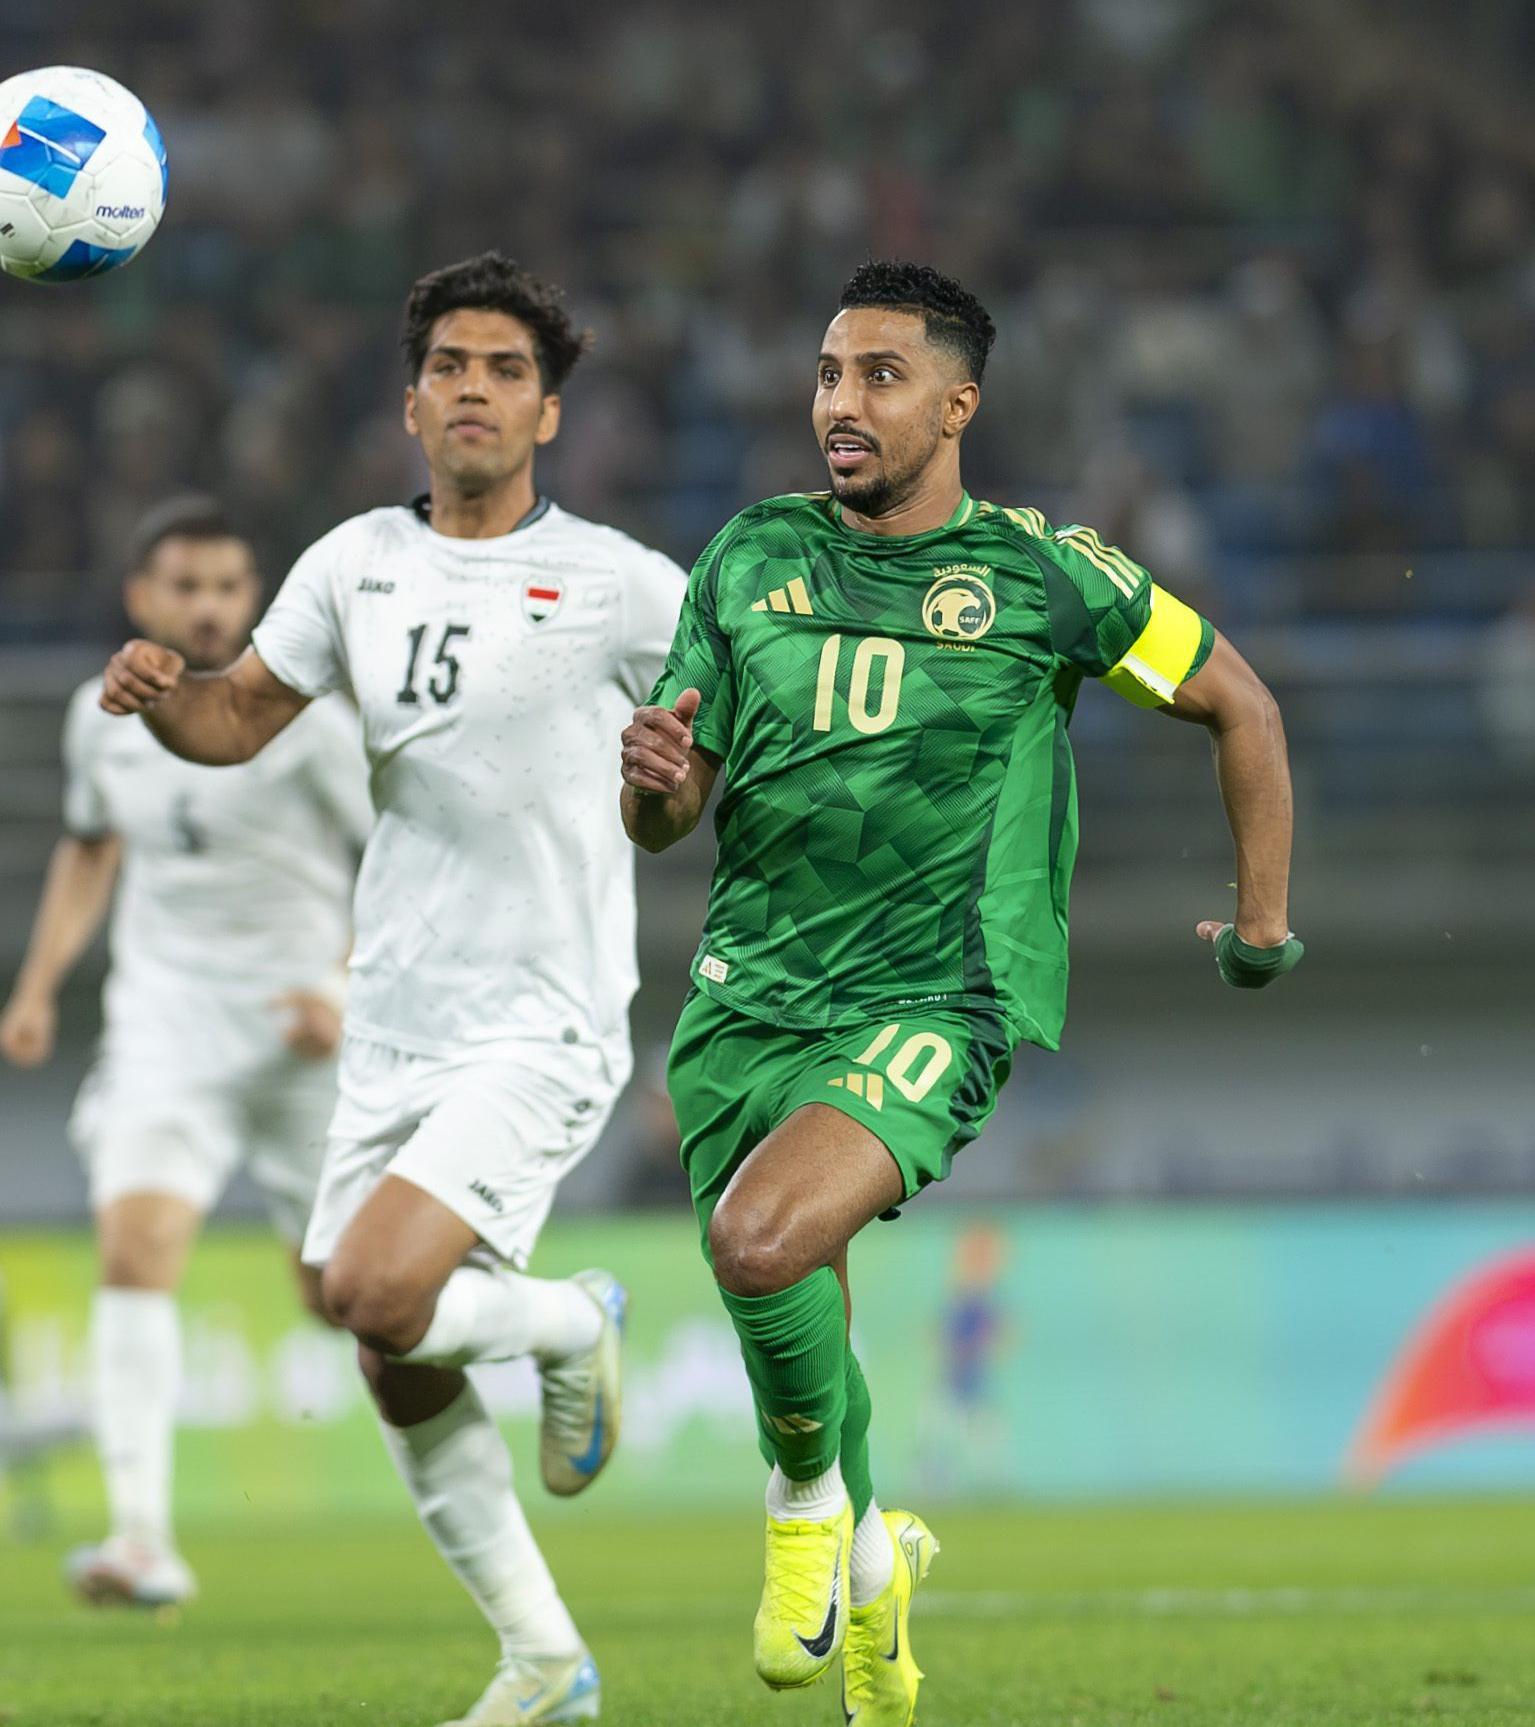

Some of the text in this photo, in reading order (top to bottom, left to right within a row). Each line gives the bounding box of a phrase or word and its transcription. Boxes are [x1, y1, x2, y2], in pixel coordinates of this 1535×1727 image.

[96, 205, 144, 219] molten
[933, 564, 992, 577] السعودية
[959, 616, 981, 624] SAFF
[396, 624, 470, 703] 15
[813, 633, 905, 735] 10
[853, 1023, 953, 1103] 10
